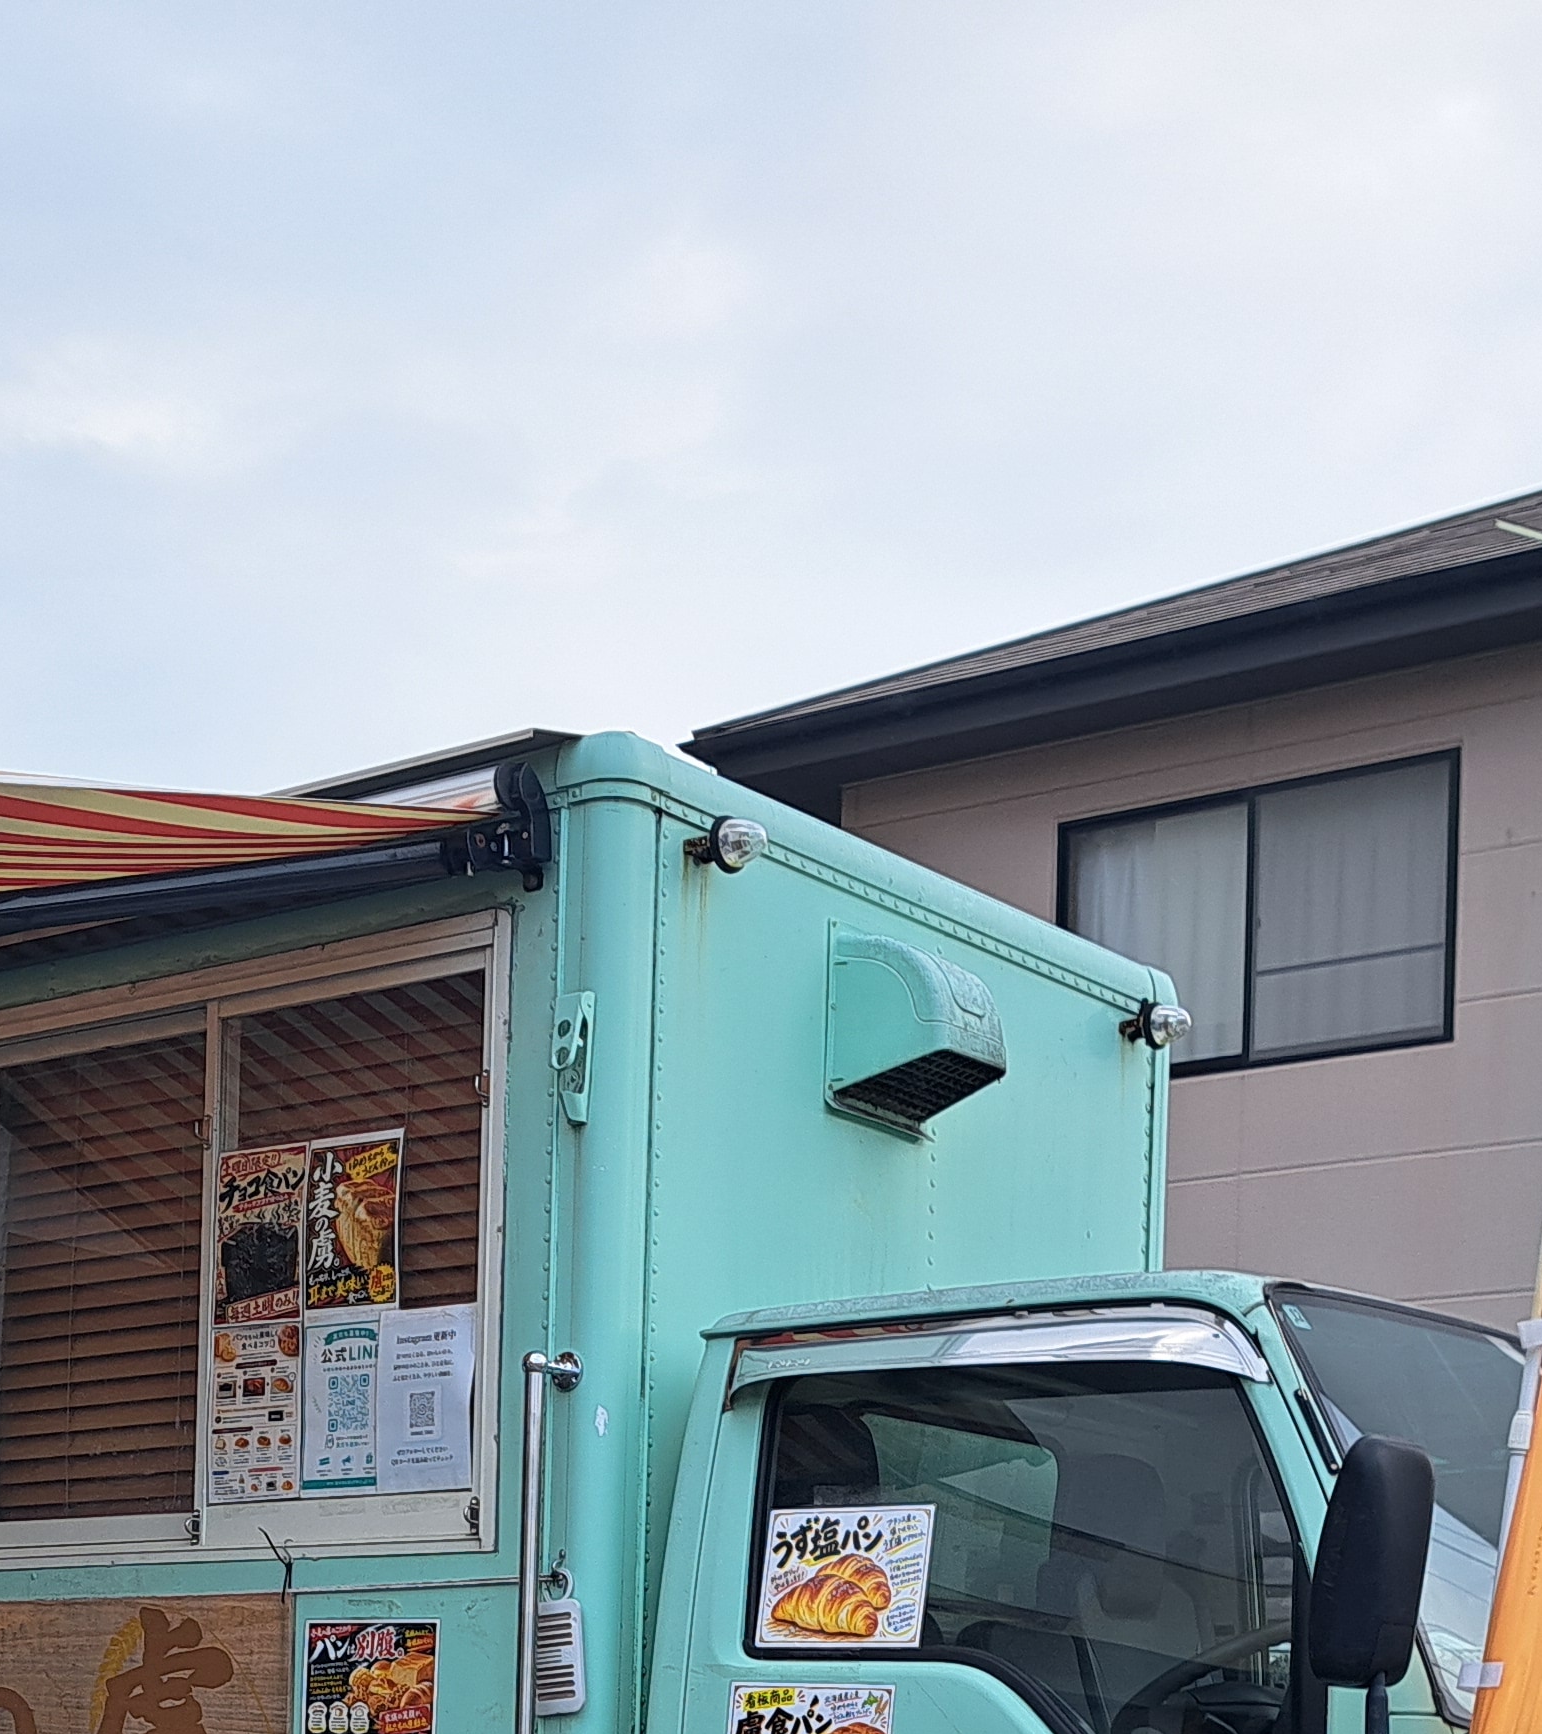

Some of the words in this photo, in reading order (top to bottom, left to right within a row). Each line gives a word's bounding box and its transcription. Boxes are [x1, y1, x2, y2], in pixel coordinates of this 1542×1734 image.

[219, 1167, 305, 1214] チョコ食パン
[308, 1152, 343, 1269] 小麦の虜。
[772, 1515, 883, 1568] うず塩パン
[309, 1625, 405, 1663] パンは別腹。
